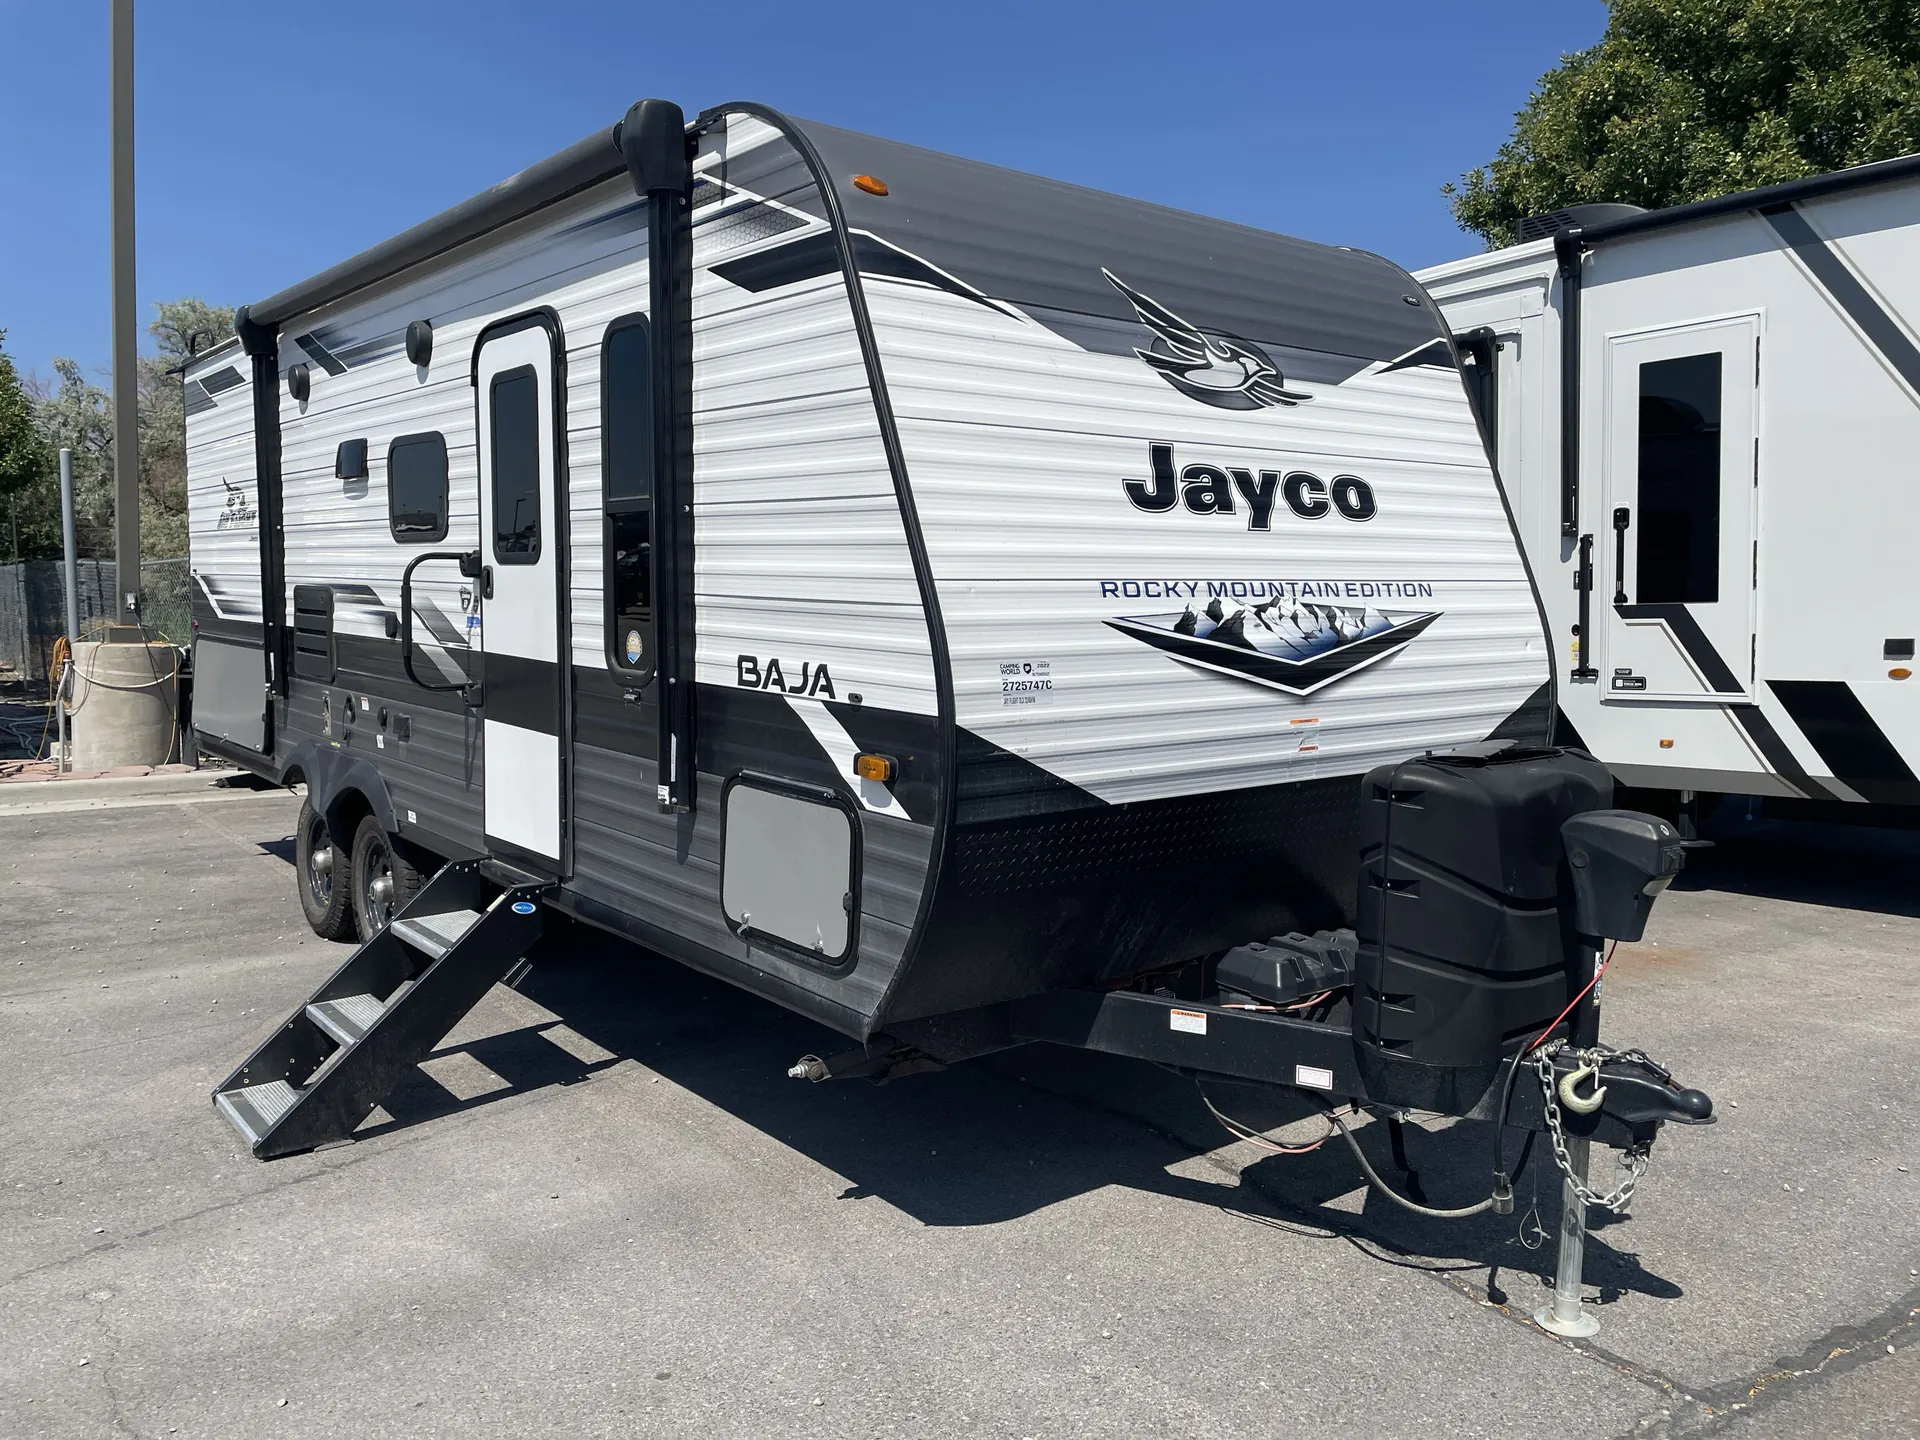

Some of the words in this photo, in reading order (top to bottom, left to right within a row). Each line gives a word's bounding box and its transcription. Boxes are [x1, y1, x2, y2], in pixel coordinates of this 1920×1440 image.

[1121, 441, 1378, 532] Jayco
[1099, 581, 1199, 600] ROCKY
[1206, 581, 1341, 599] MOUNTAIN
[1347, 582, 1434, 598] EDITION
[737, 654, 836, 700] BAJA
[1002, 680, 1052, 691] 2725747C
